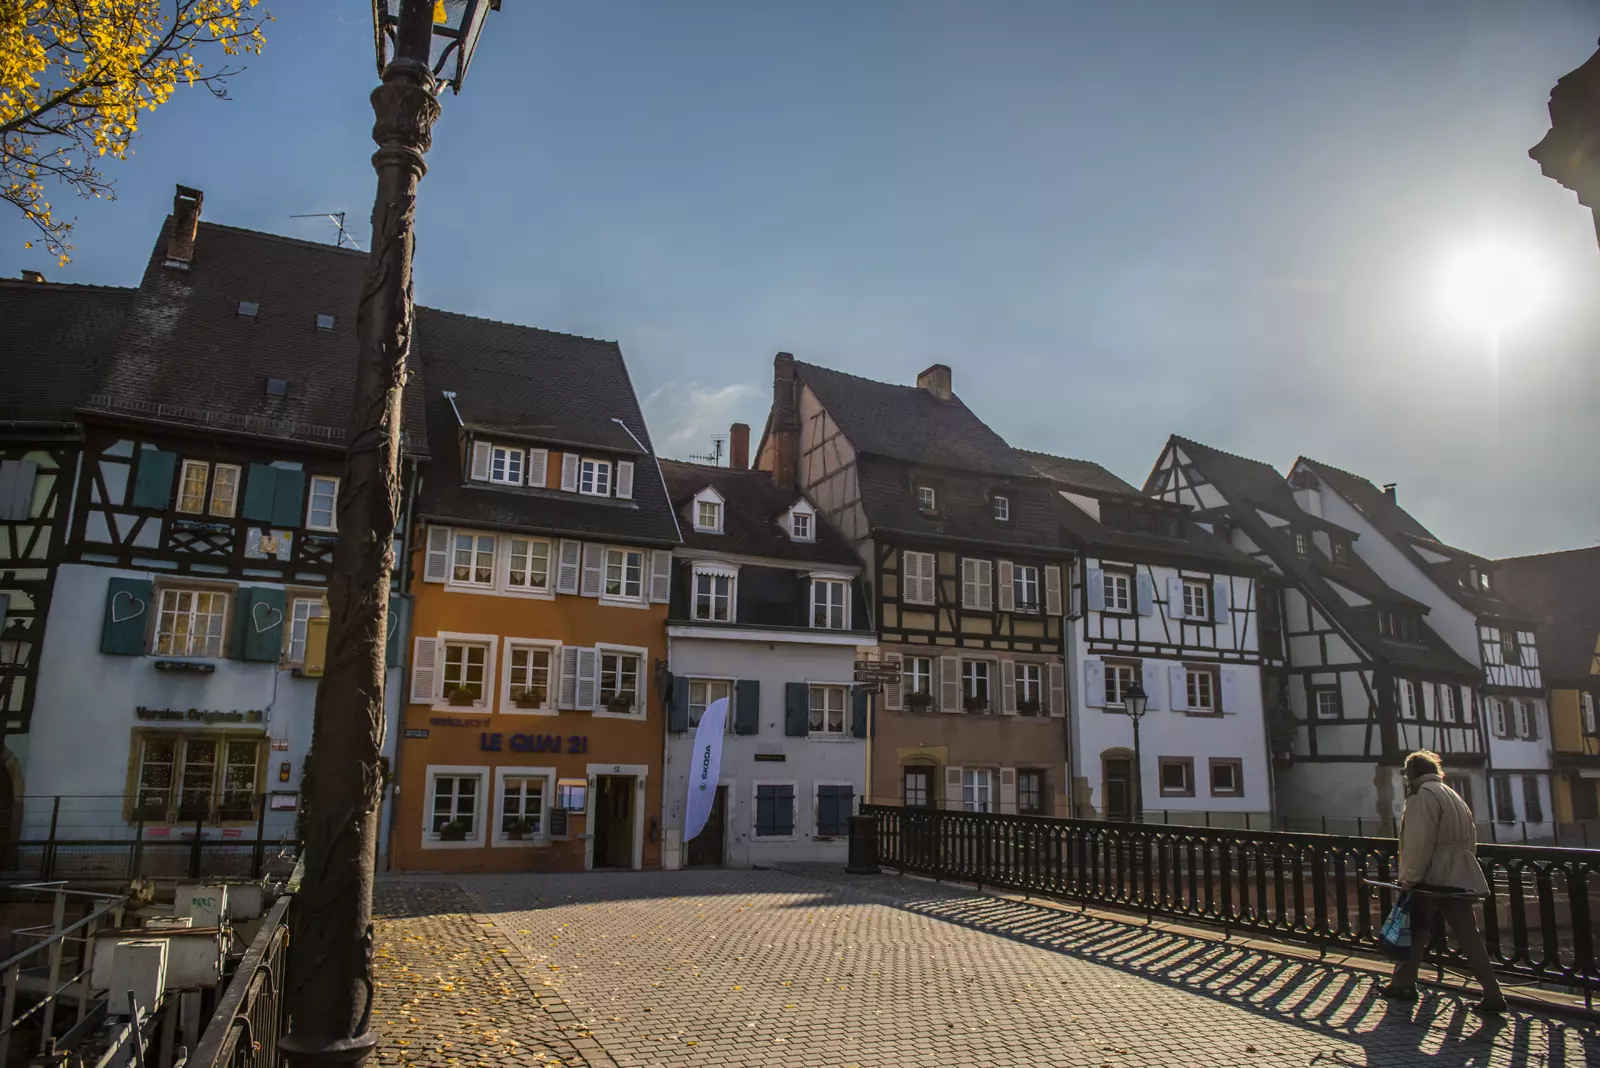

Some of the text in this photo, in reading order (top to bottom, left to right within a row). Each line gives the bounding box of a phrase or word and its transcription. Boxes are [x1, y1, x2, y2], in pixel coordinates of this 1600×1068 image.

[480, 732, 588, 754] LE QUAI 21
